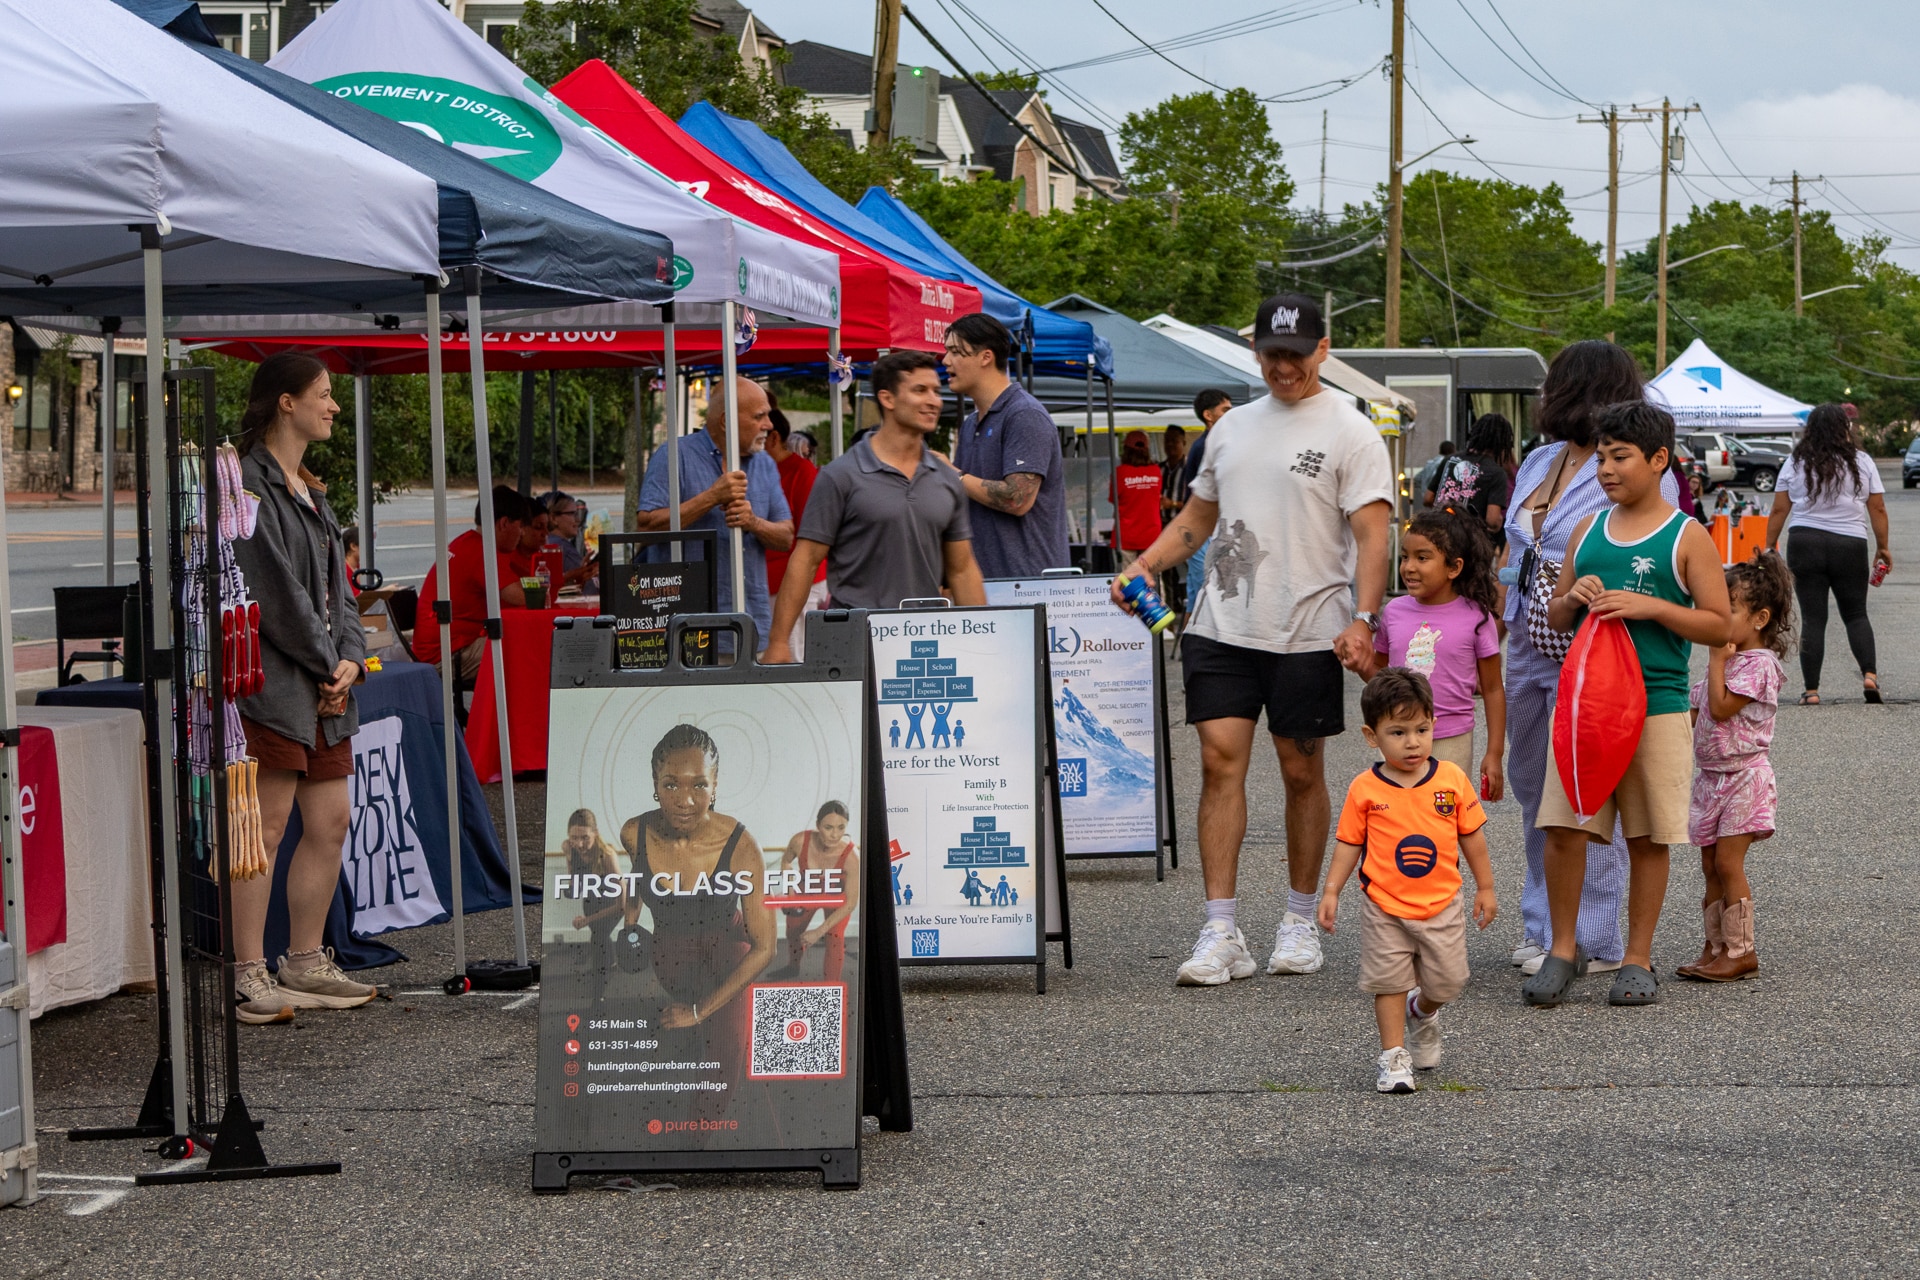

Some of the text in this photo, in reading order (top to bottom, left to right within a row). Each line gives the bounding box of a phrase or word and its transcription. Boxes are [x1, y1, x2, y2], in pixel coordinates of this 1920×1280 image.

[327, 84, 534, 141] OVEMENT DISTRICT
[1720, 410, 1762, 419] Hospital
[640, 575, 683, 589] OM ORGANICS
[1014, 589, 1041, 598] Insure
[1049, 588, 1075, 597] Invest
[1051, 600, 1075, 608] 401(k)
[1091, 600, 1106, 608] past
[1071, 610, 1108, 619] retirement
[617, 617, 632, 630] COLD
[632, 616, 653, 630] PRESS
[903, 620, 926, 637] for
[931, 619, 957, 636] the
[961, 618, 997, 635] Best
[1082, 638, 1145, 653] Rollover
[1052, 669, 1091, 678] IREMENT
[1093, 679, 1152, 687] POST-RETIREMENT
[887, 689, 908, 697] Savings
[911, 756, 931, 769] for
[934, 755, 956, 768] the
[959, 755, 1000, 768] Worst
[1058, 771, 1084, 783] ORK
[964, 779, 1007, 791] Family B
[1060, 781, 1081, 792] IFE
[942, 803, 1029, 812] Life Insurance Protection
[554, 868, 843, 900] FIRST CLASS FREE
[903, 916, 932, 926] Make
[934, 915, 957, 925] Sure
[959, 914, 990, 924] You're
[991, 914, 1023, 925] Family
[1026, 914, 1033, 922] B
[915, 932, 936, 940] NEW
[914, 939, 938, 947] YORK
[916, 946, 935, 954] LIFE
[589, 1019, 648, 1029] 345 Main St
[588, 1040, 659, 1050] 631-351-4859
[587, 1060, 721, 1073] huntington@purebarre.com
[586, 1081, 728, 1094] @purebarrehuntingtonvillage
[665, 1117, 738, 1134] pure barre
